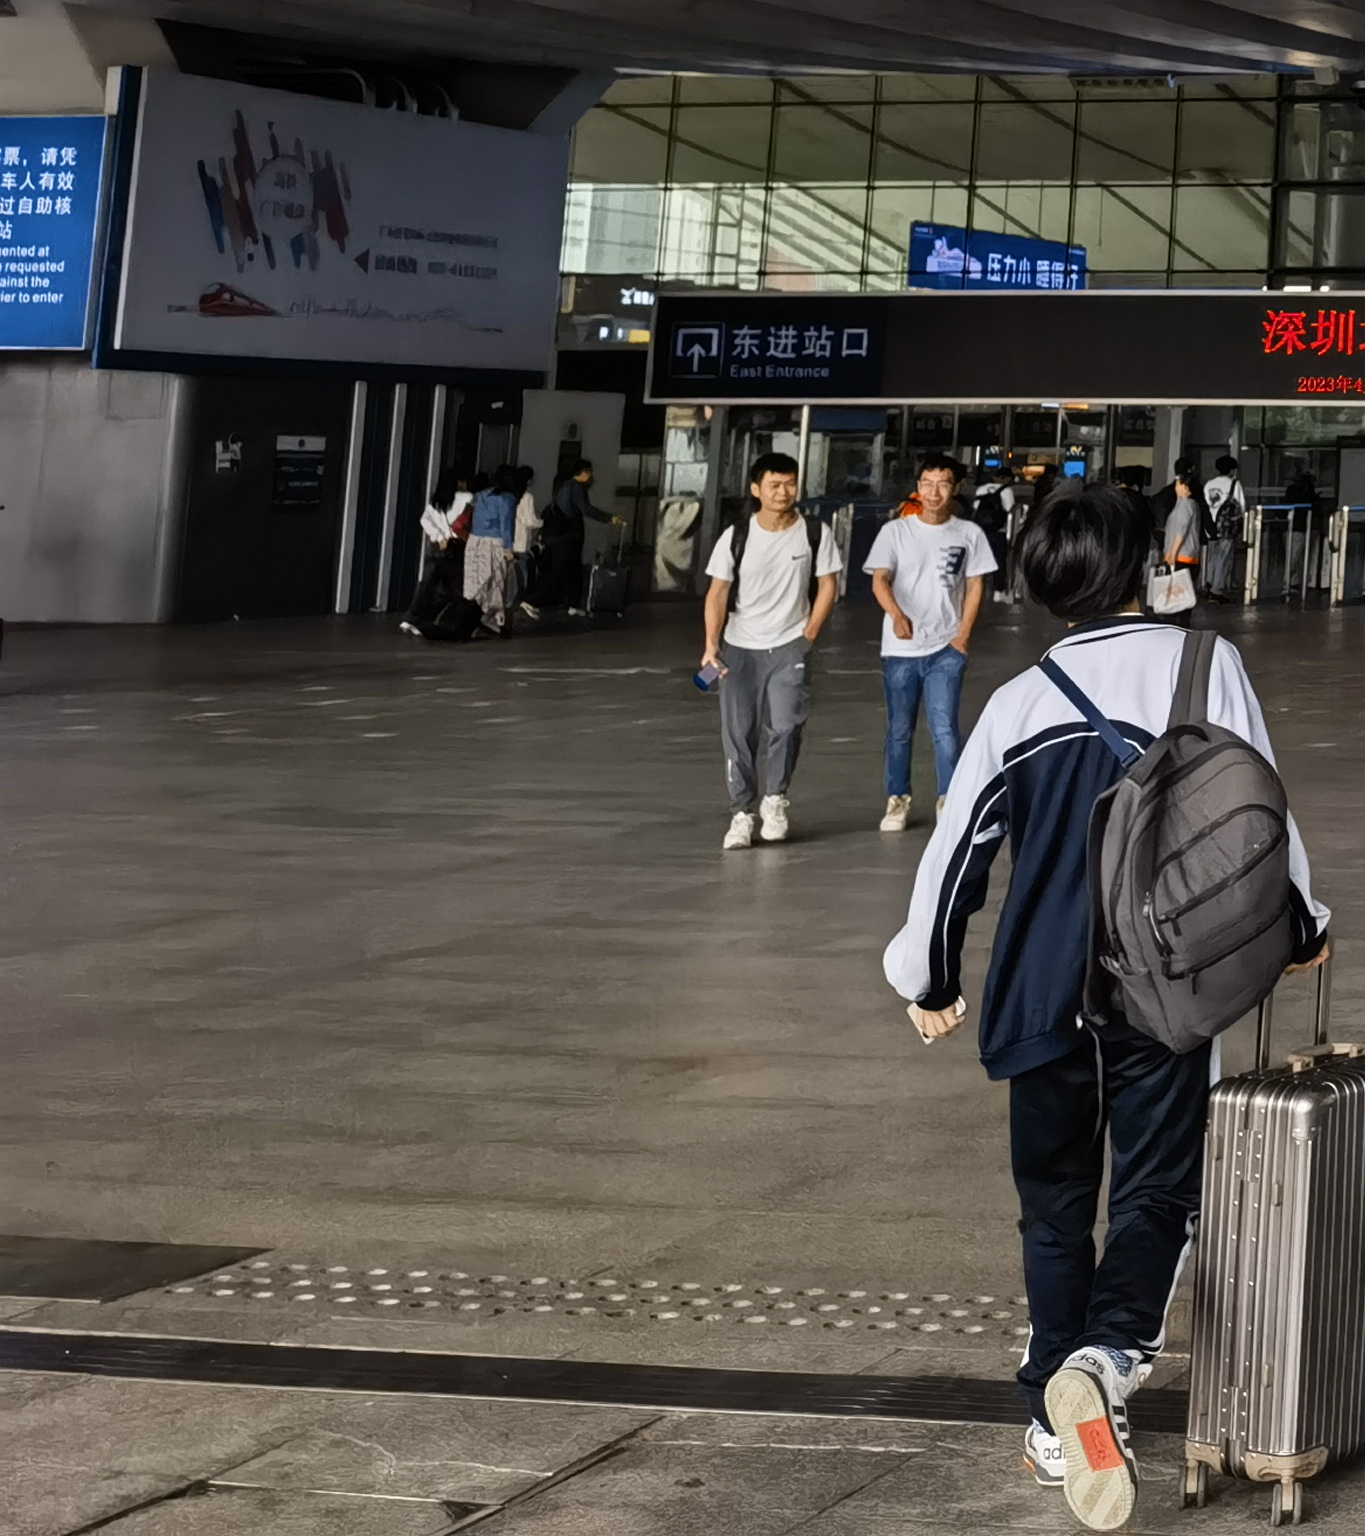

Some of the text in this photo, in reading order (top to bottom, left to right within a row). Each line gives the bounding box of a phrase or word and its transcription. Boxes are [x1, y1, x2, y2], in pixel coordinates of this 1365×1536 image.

[0, 147, 77, 166] 票，请凭
[1, 171, 74, 191] 车人有效
[0, 196, 72, 215] 过自助核
[5, 261, 65, 274] requested
[31, 275, 50, 288] the
[19, 291, 30, 303] to
[33, 291, 63, 303] enter
[732, 325, 868, 359] 东进站口
[730, 364, 830, 378] East Entrance
